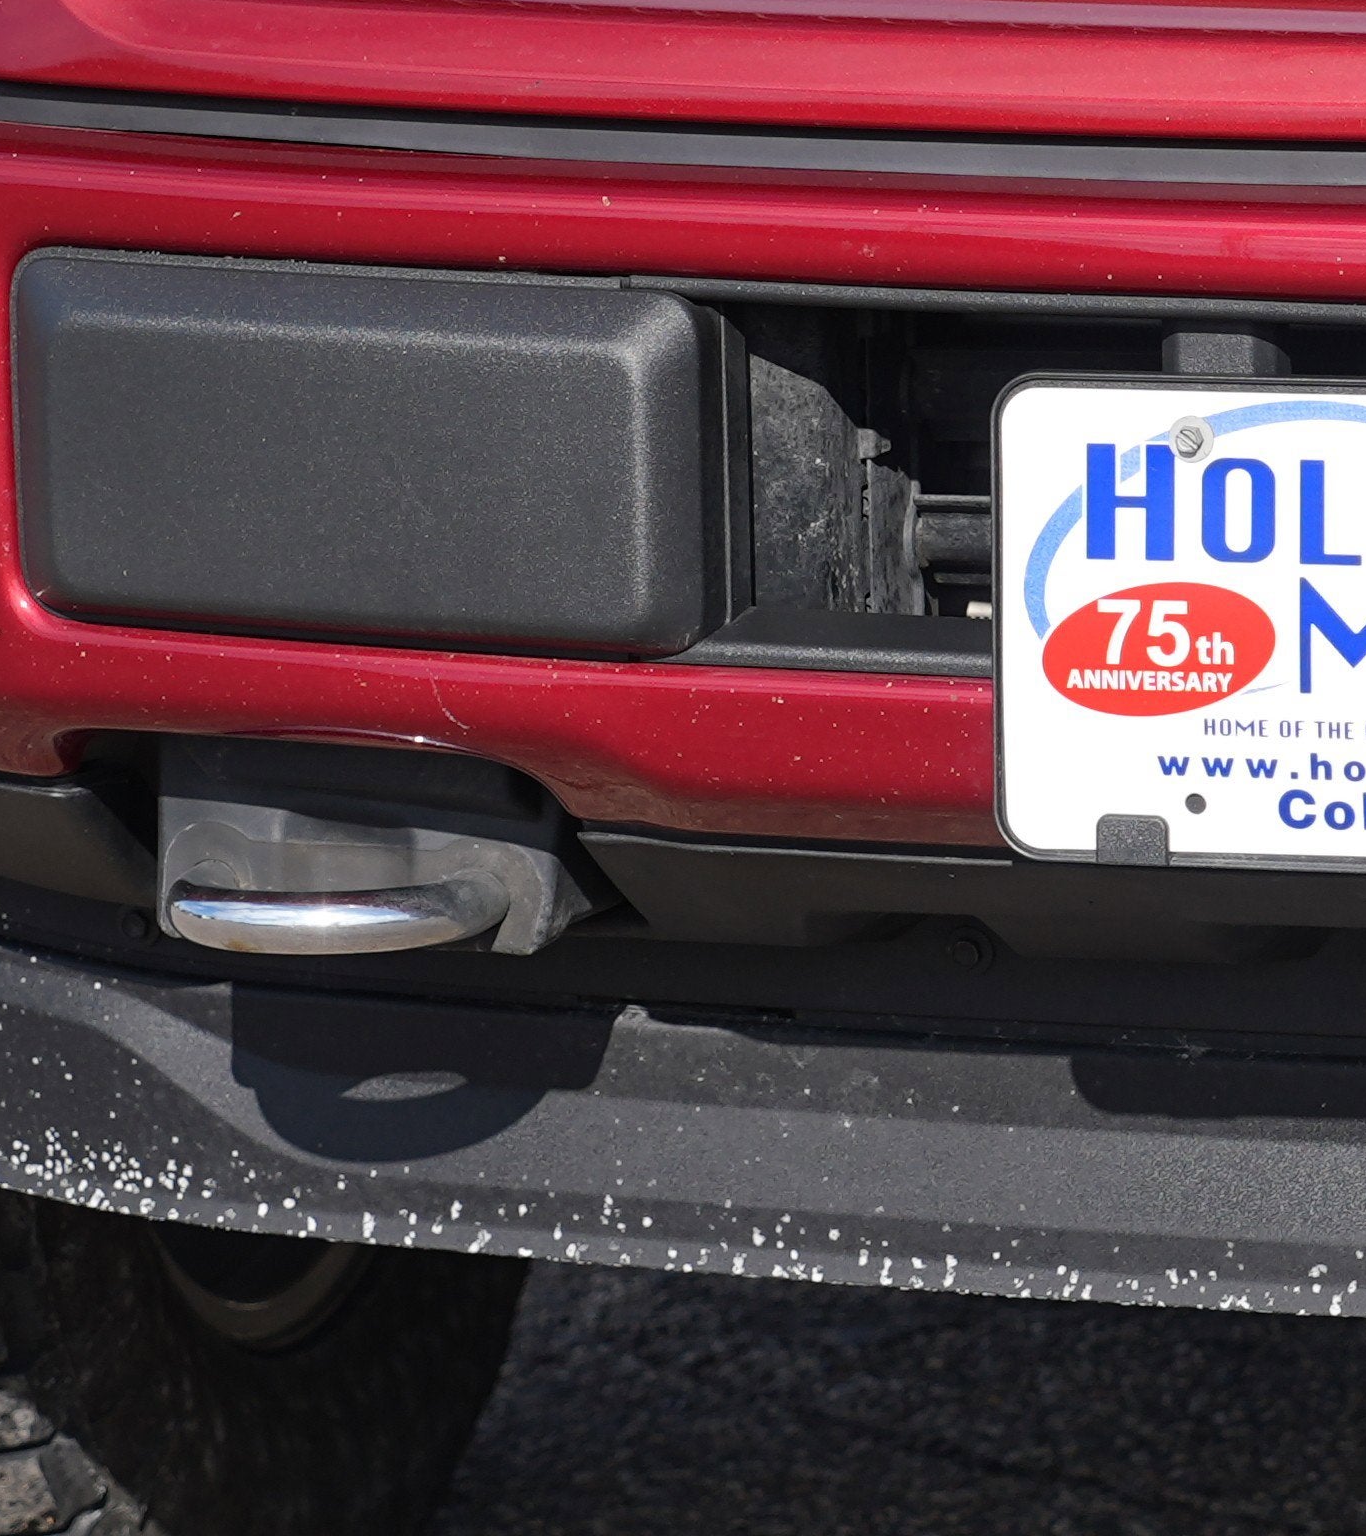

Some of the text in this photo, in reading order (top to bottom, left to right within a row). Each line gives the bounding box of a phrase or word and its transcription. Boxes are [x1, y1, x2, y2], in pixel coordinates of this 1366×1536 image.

[1096, 598, 1235, 668] 75th
[1066, 669, 1233, 694] ANNIVERSARY
[1203, 718, 1269, 738] HOME
[1279, 720, 1304, 739] OF
[1314, 720, 1354, 740] THE
